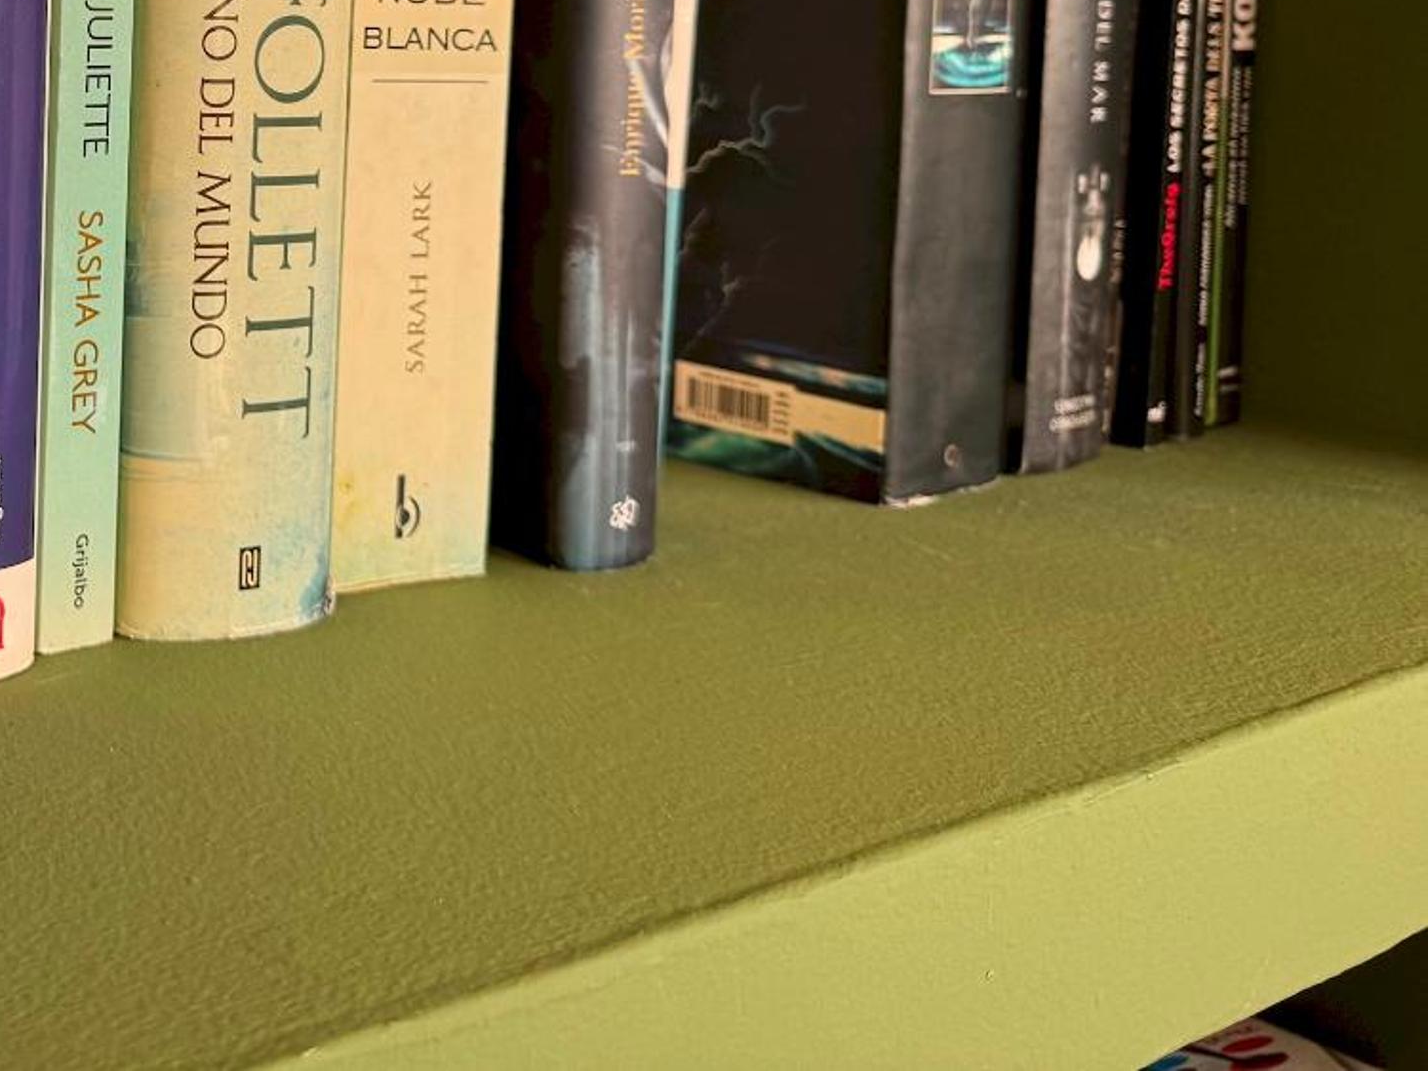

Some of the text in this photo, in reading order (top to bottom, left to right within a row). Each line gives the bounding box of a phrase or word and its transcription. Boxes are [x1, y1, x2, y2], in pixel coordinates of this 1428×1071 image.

[81, 0, 114, 159] JULIETTE
[363, 26, 498, 53] BLANCA
[1089, 60, 1111, 123] MAR
[197, 76, 236, 156] DEL
[620, 72, 648, 178] Enrique
[189, 170, 233, 360] MUNDO
[405, 181, 434, 374] SARAH LARK
[70, 208, 104, 435] SASHA GREY
[71, 532, 90, 610] Grijalbo
